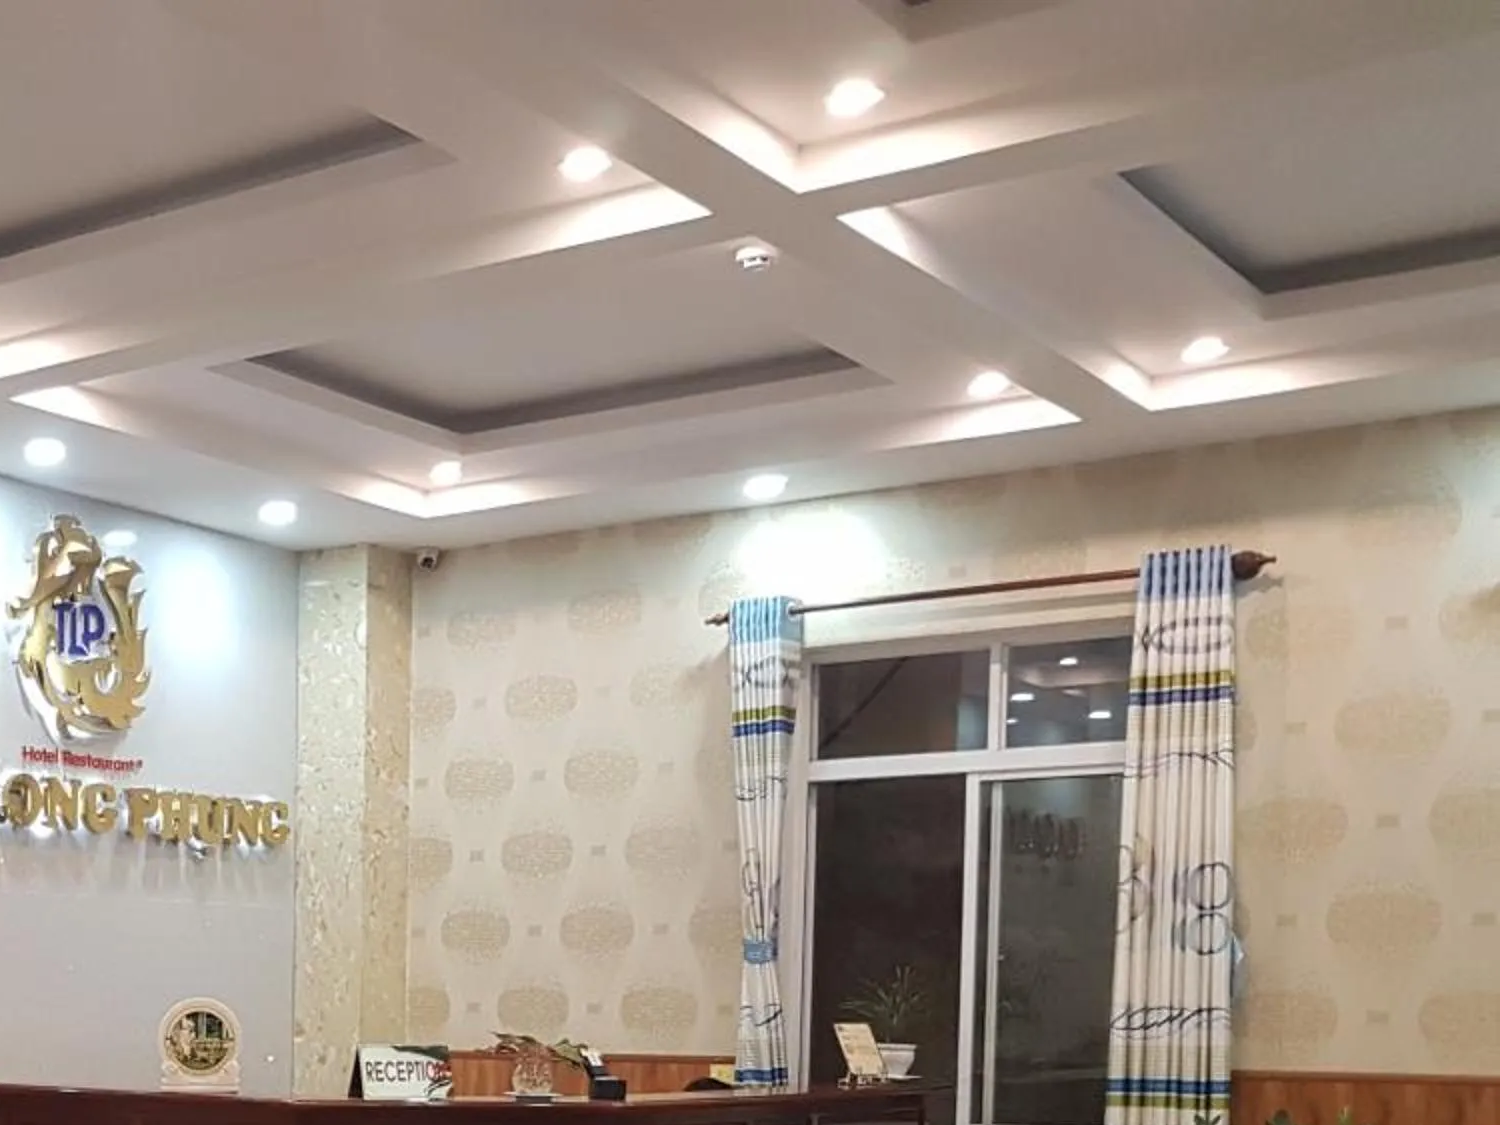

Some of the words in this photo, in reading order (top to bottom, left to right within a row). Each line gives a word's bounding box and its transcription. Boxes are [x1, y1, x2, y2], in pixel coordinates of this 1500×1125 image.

[52, 601, 105, 657] TLP
[21, 745, 59, 764] Hotel
[61, 749, 135, 772] Restaurant
